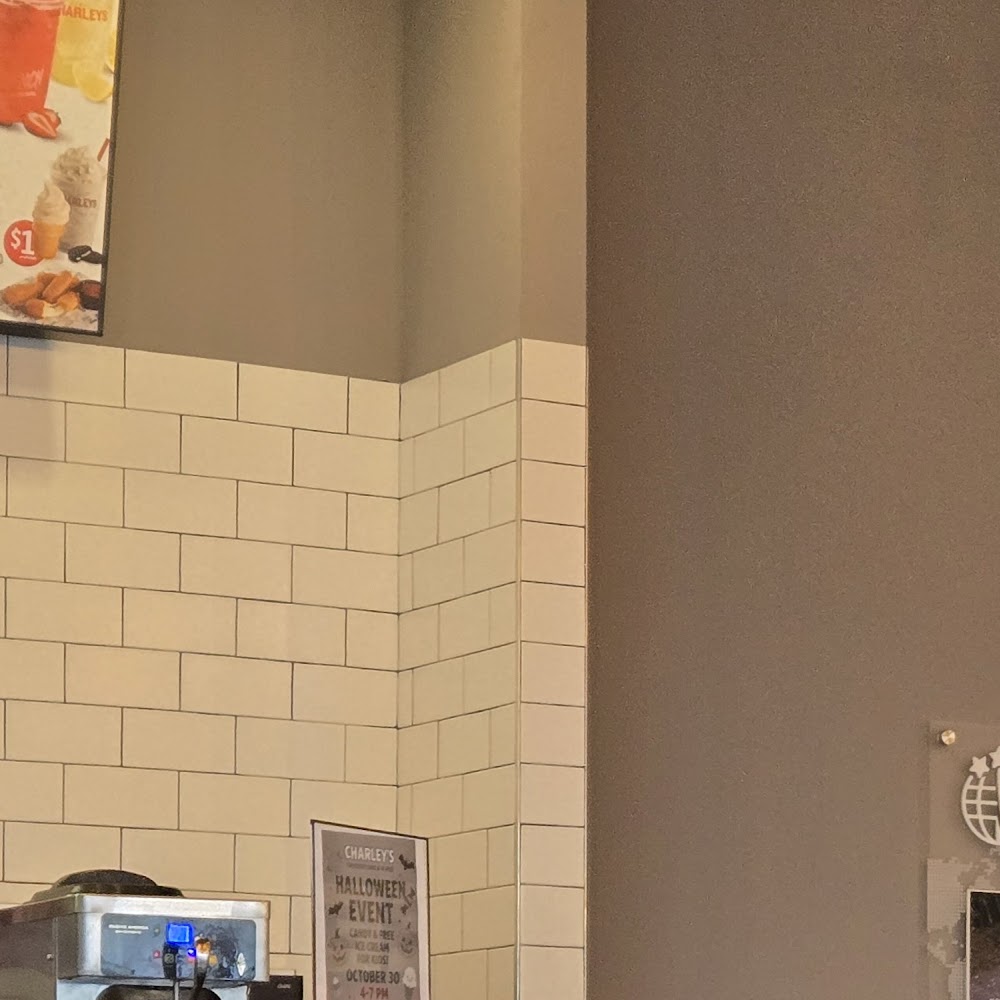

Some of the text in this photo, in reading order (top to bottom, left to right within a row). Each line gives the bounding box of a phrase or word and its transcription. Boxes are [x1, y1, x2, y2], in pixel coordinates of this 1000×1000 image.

[10, 226, 35, 255] $1
[335, 875, 406, 899] HALLOWEEN
[349, 900, 393, 924] EVENT
[346, 969, 400, 985] OCTOBER 30
[376, 987, 389, 1000] PM
